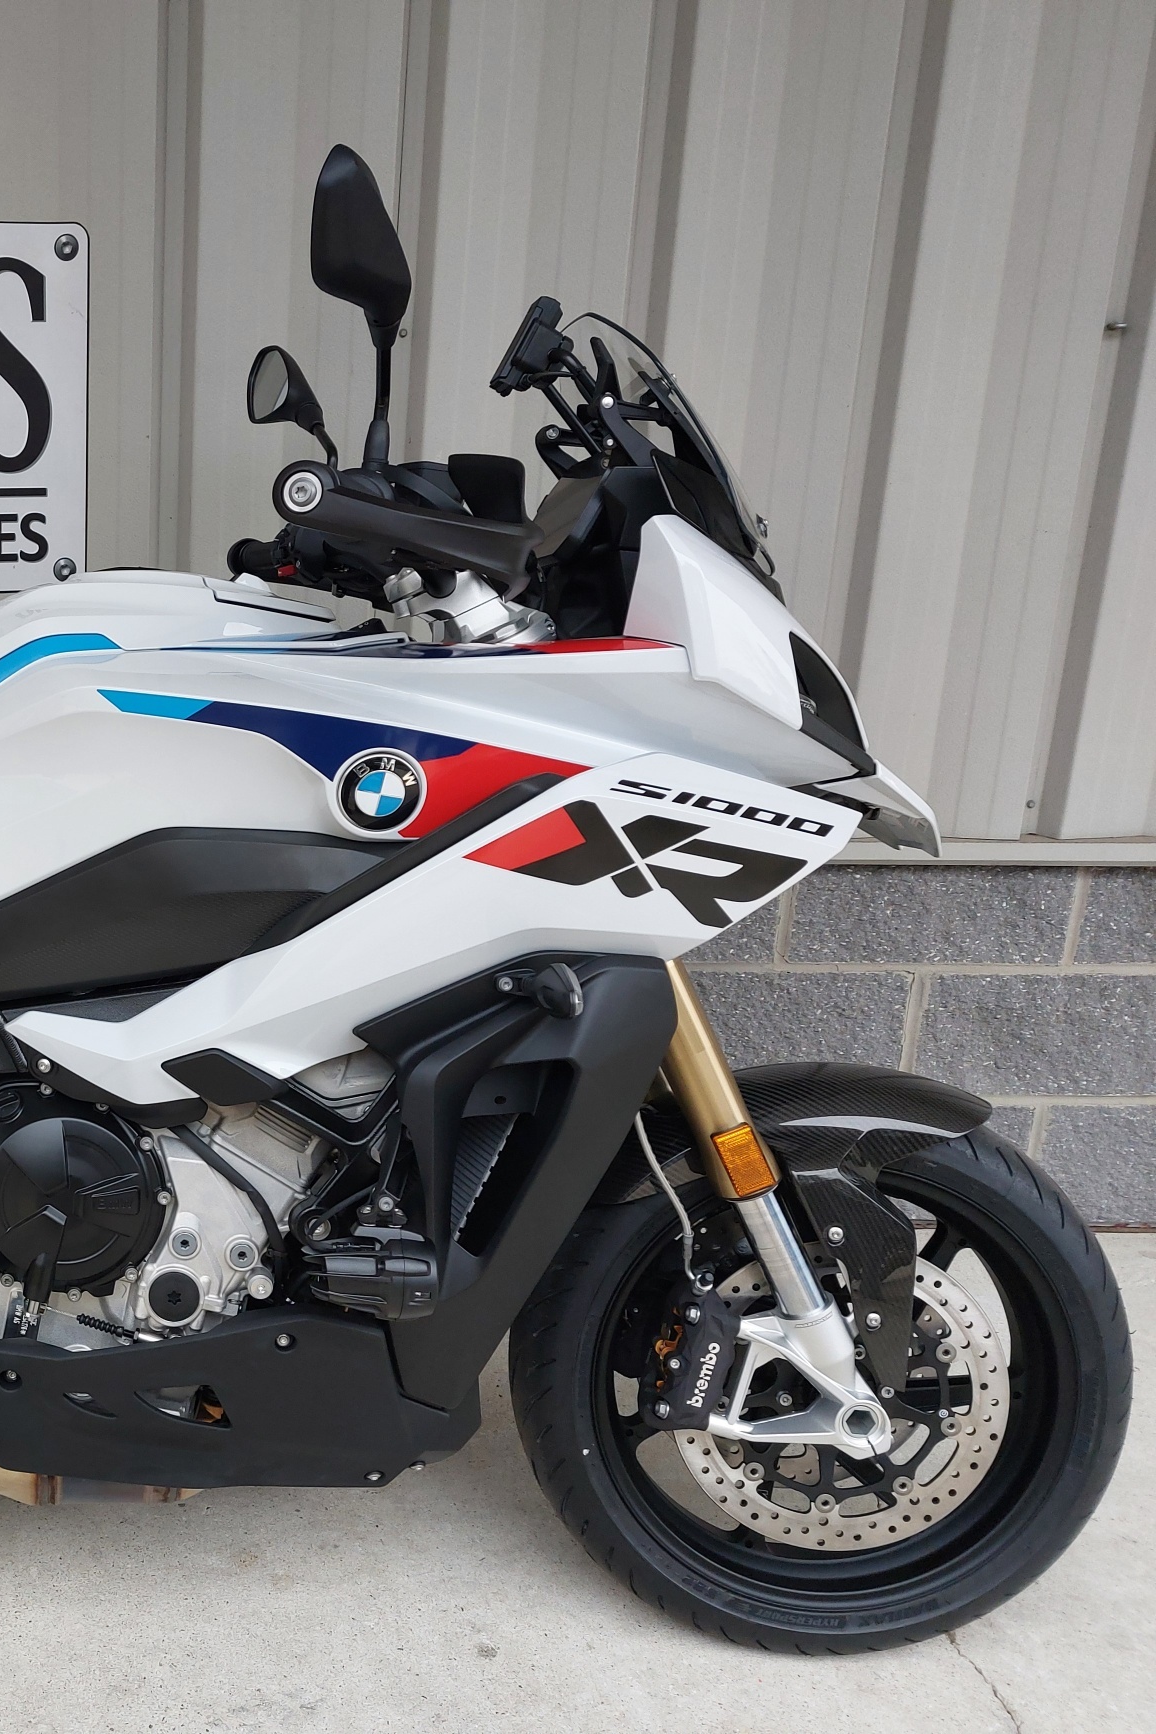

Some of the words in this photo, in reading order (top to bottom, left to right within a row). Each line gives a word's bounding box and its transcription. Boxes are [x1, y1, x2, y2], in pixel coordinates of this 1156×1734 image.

[353, 757, 418, 787] BMW
[609, 779, 835, 837] S1000
[686, 1342, 721, 1408] brembo
